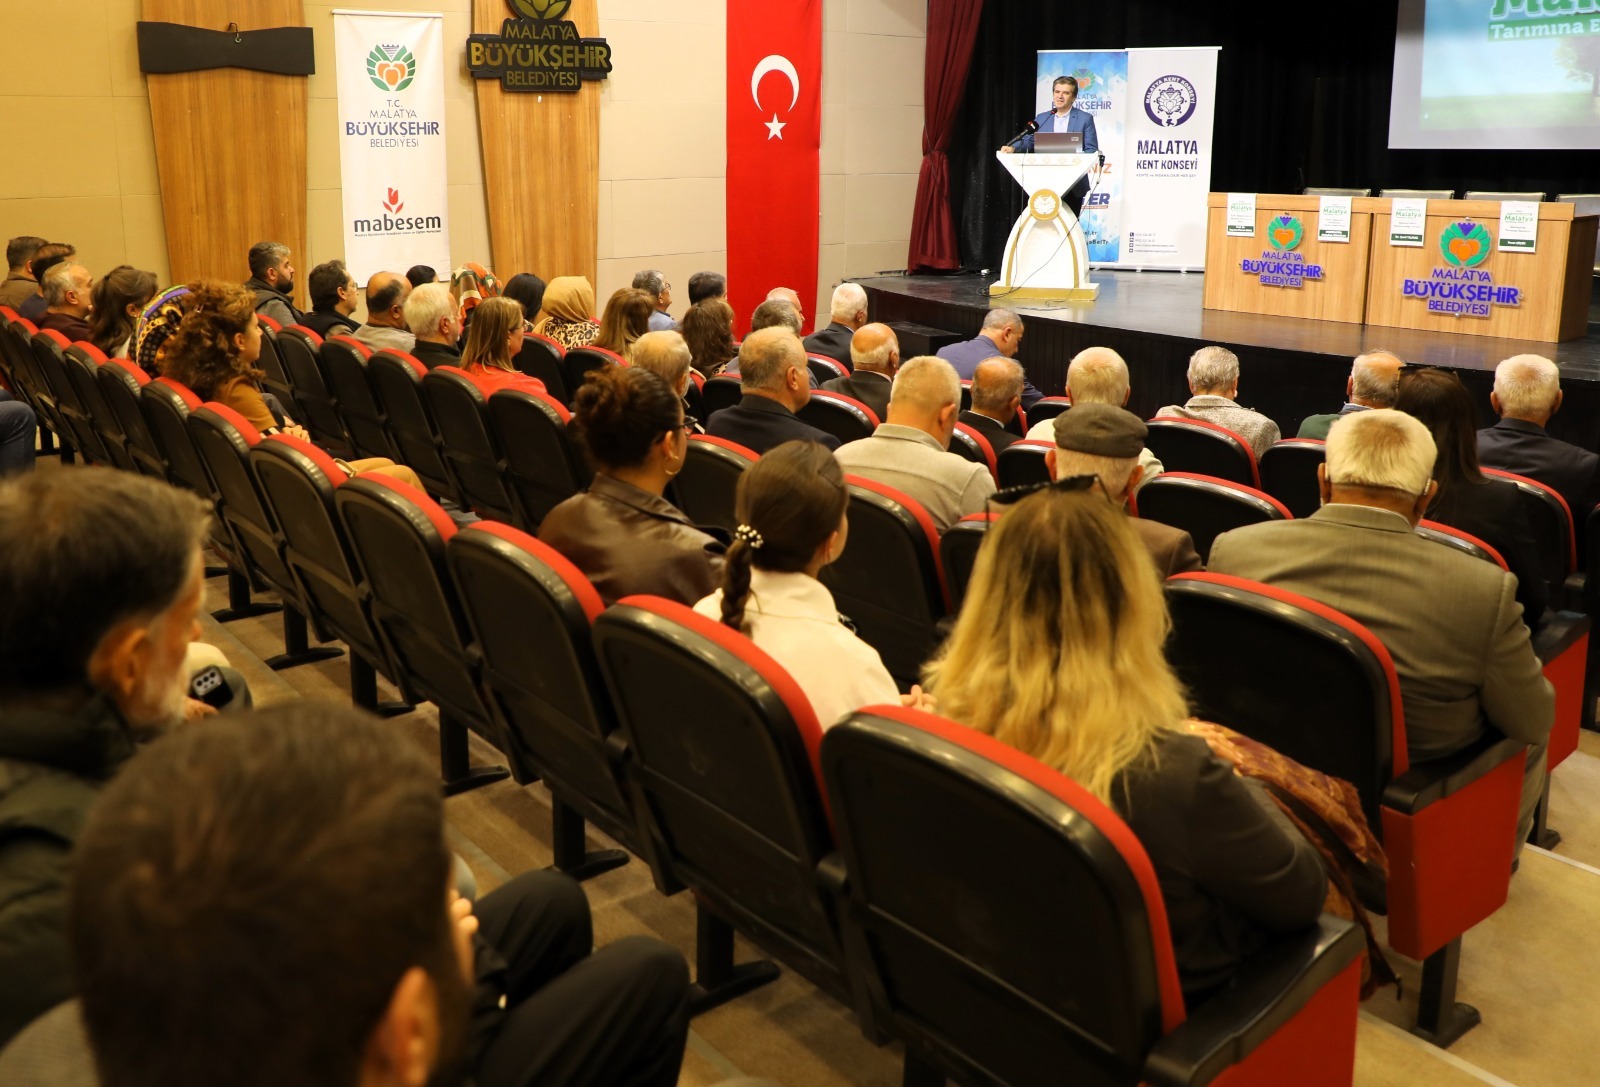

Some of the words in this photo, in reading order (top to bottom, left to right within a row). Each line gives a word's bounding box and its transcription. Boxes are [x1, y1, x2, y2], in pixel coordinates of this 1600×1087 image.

[505, 23, 576, 40] MALATYA
[1490, 21, 1584, 39] Tarımına
[470, 42, 608, 70] BÜYÜKŞEHİR
[506, 70, 578, 86] BELEDİYESİ
[386, 99, 403, 108] T.C.
[369, 109, 417, 118] MALATYA
[346, 121, 440, 137] BÜYÜKŞEHİR
[370, 138, 419, 147] BELEDİYESİ
[1137, 140, 1198, 154] MALATYA
[1136, 160, 1159, 170] KENT
[1161, 158, 1198, 170] KONSEYİ
[354, 213, 441, 232] mabesem
[1262, 251, 1303, 261] MALATYA
[1242, 259, 1321, 277] BÜYÜKŞEHİR
[1431, 268, 1491, 282] MALATYA
[1260, 274, 1302, 286] BELEDİYESİ
[1403, 279, 1519, 304] BÜYÜKŞEHİR
[1428, 300, 1489, 315] BELEDİYESİ
